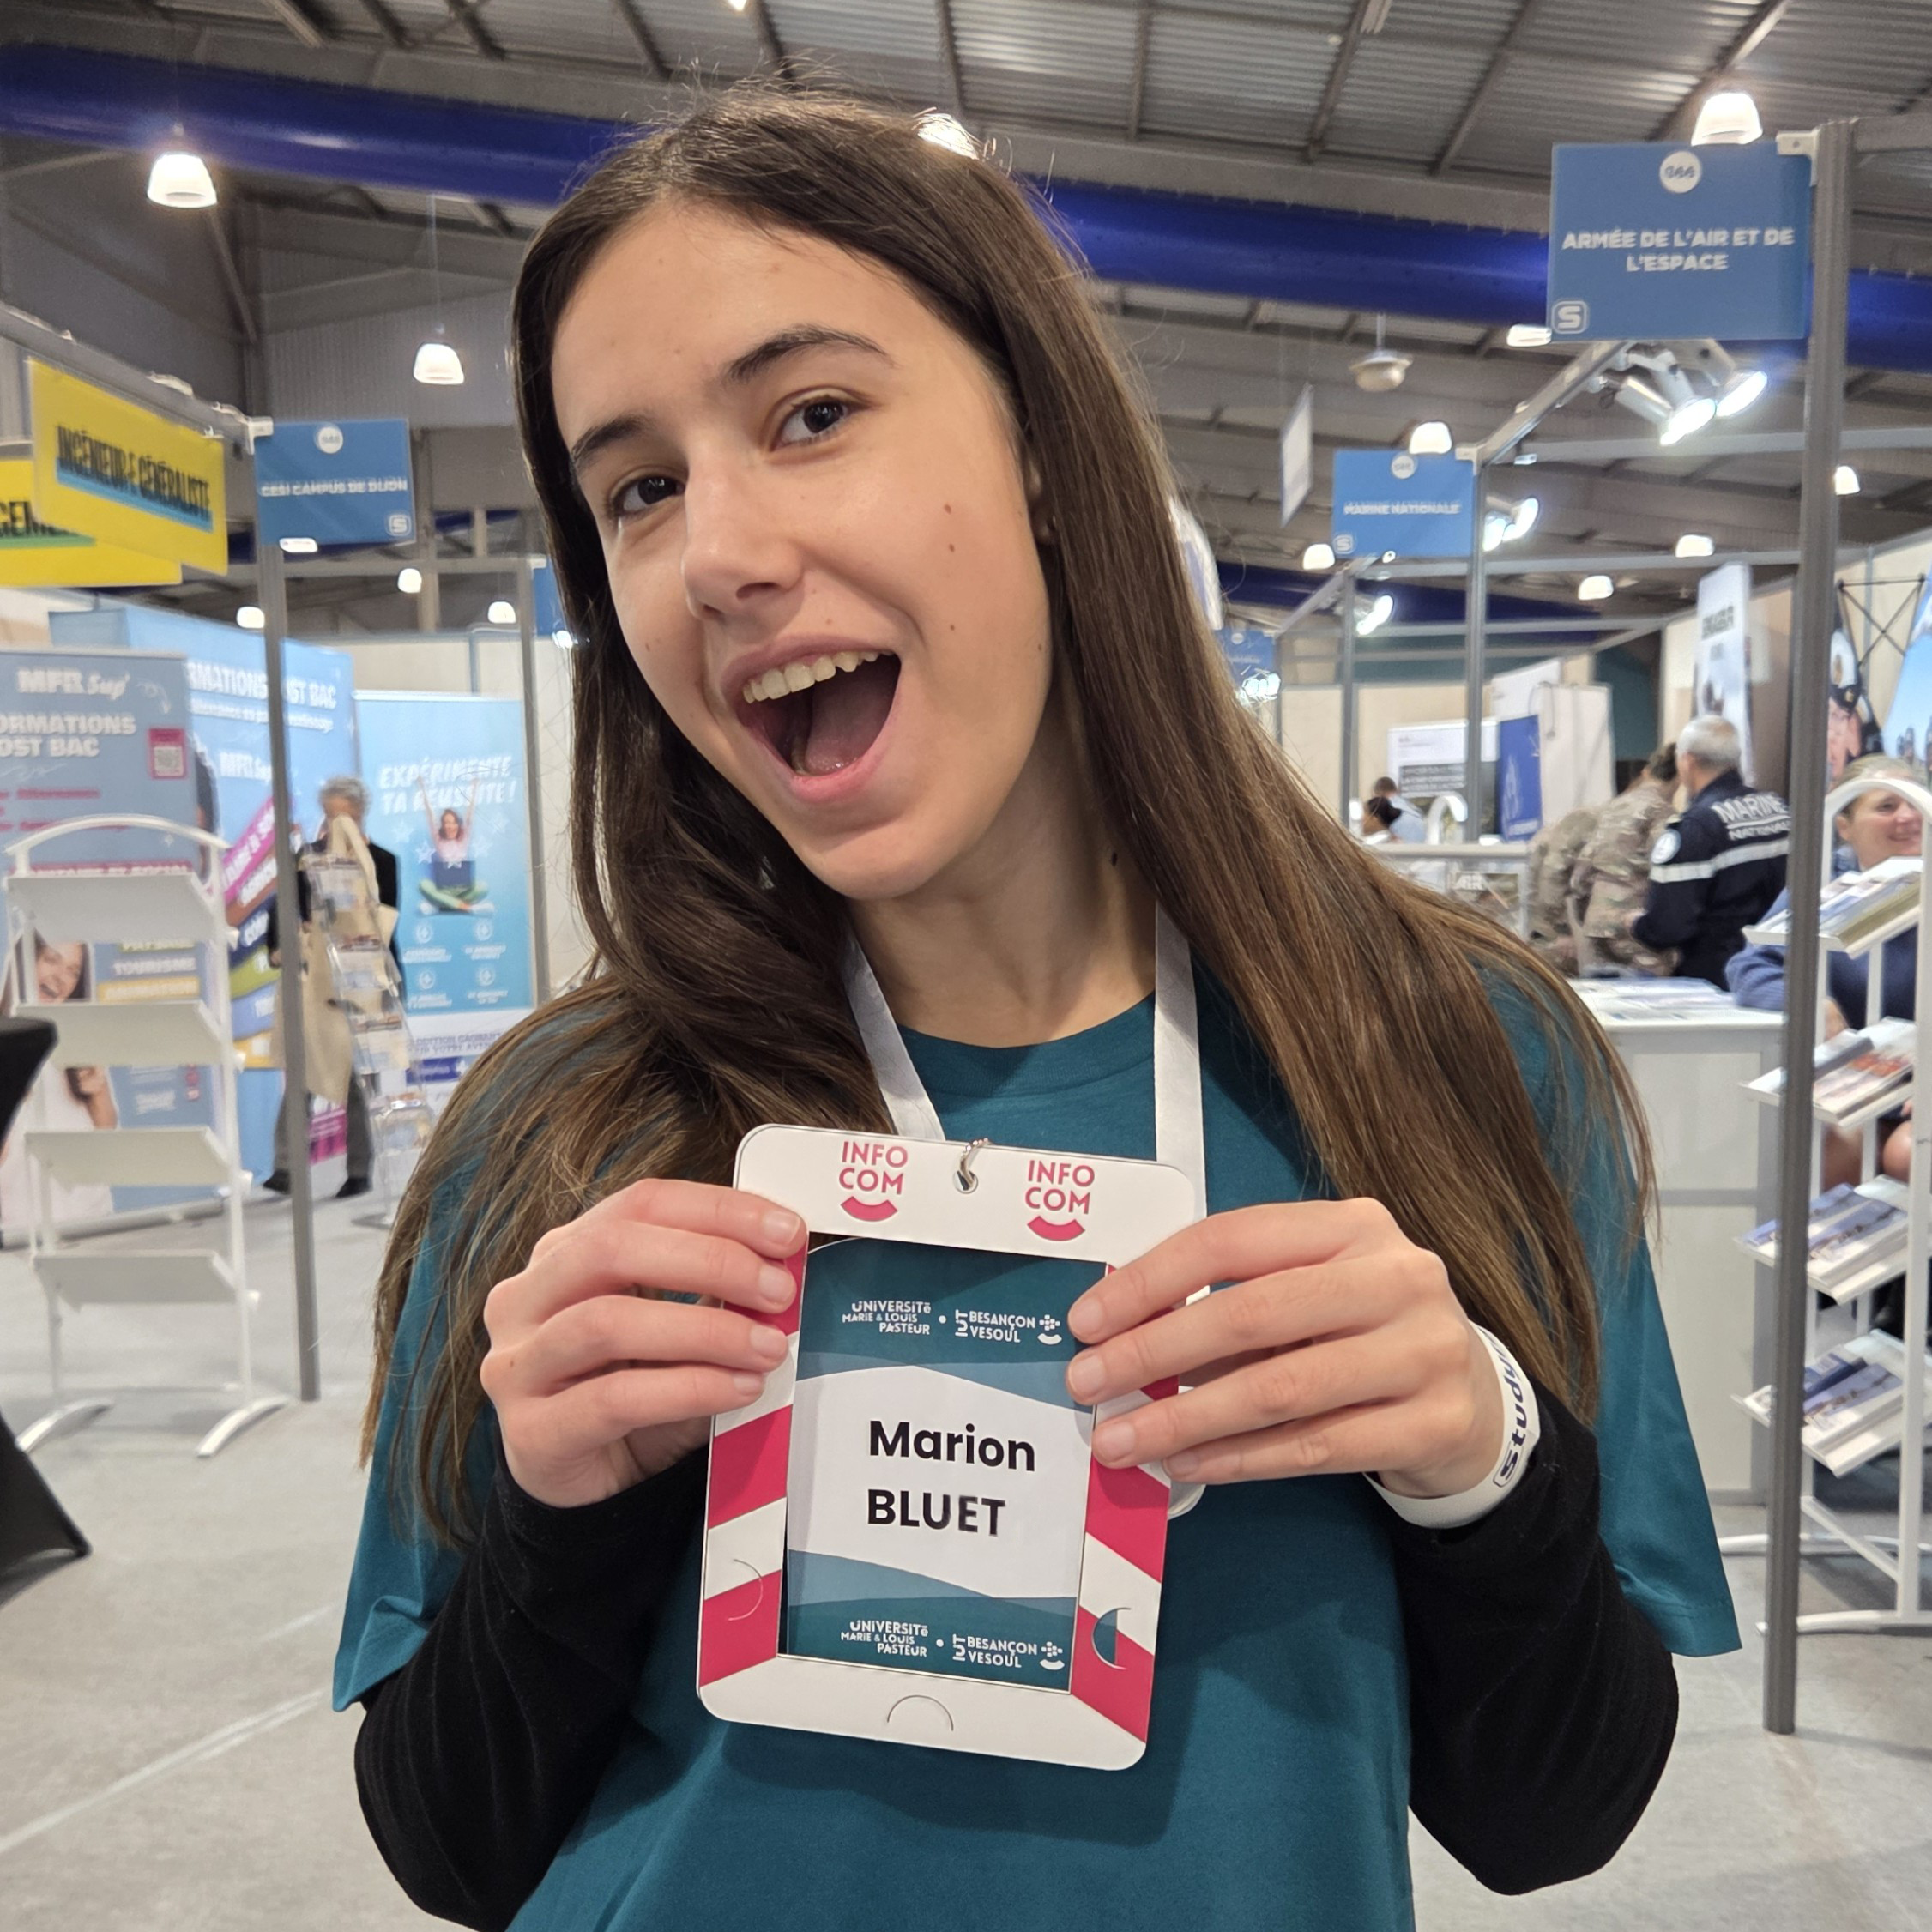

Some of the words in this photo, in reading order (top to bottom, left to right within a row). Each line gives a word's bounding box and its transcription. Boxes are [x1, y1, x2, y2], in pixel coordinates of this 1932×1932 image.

[1561, 226, 1637, 250] ARMÉE
[1639, 229, 1670, 248] DE
[1674, 228, 1730, 247] L'AIR
[1732, 228, 1760, 246] ET
[1764, 228, 1795, 245] DE
[1627, 254, 1730, 272] L'ESPACE
[293, 480, 346, 495] CAMPUS
[347, 479, 366, 492] DE
[1343, 500, 1390, 515] MARINE
[1391, 500, 1461, 515] NATIONALE
[49, 736, 100, 758] BAC
[383, 791, 408, 815] TA
[842, 1141, 909, 1168] INFO
[838, 1168, 904, 1195] COM
[1028, 1160, 1095, 1187] INFO
[1025, 1186, 1091, 1215] COM
[842, 1313, 873, 1324] MARIE
[884, 1313, 918, 1324] LOUIS
[878, 1322, 931, 1335] PASTEUR
[969, 1310, 1036, 1331] BESANÇON
[969, 1325, 1021, 1343] VESOUL
[869, 1420, 1035, 1472] Marion
[867, 1488, 1006, 1537] BLUET
[841, 1632, 872, 1643] MARIE
[883, 1635, 915, 1645] LOUIS
[967, 1635, 1038, 1657] BESANÇON
[877, 1642, 927, 1657] PASTEUR
[968, 1651, 1023, 1669] VESOUL
